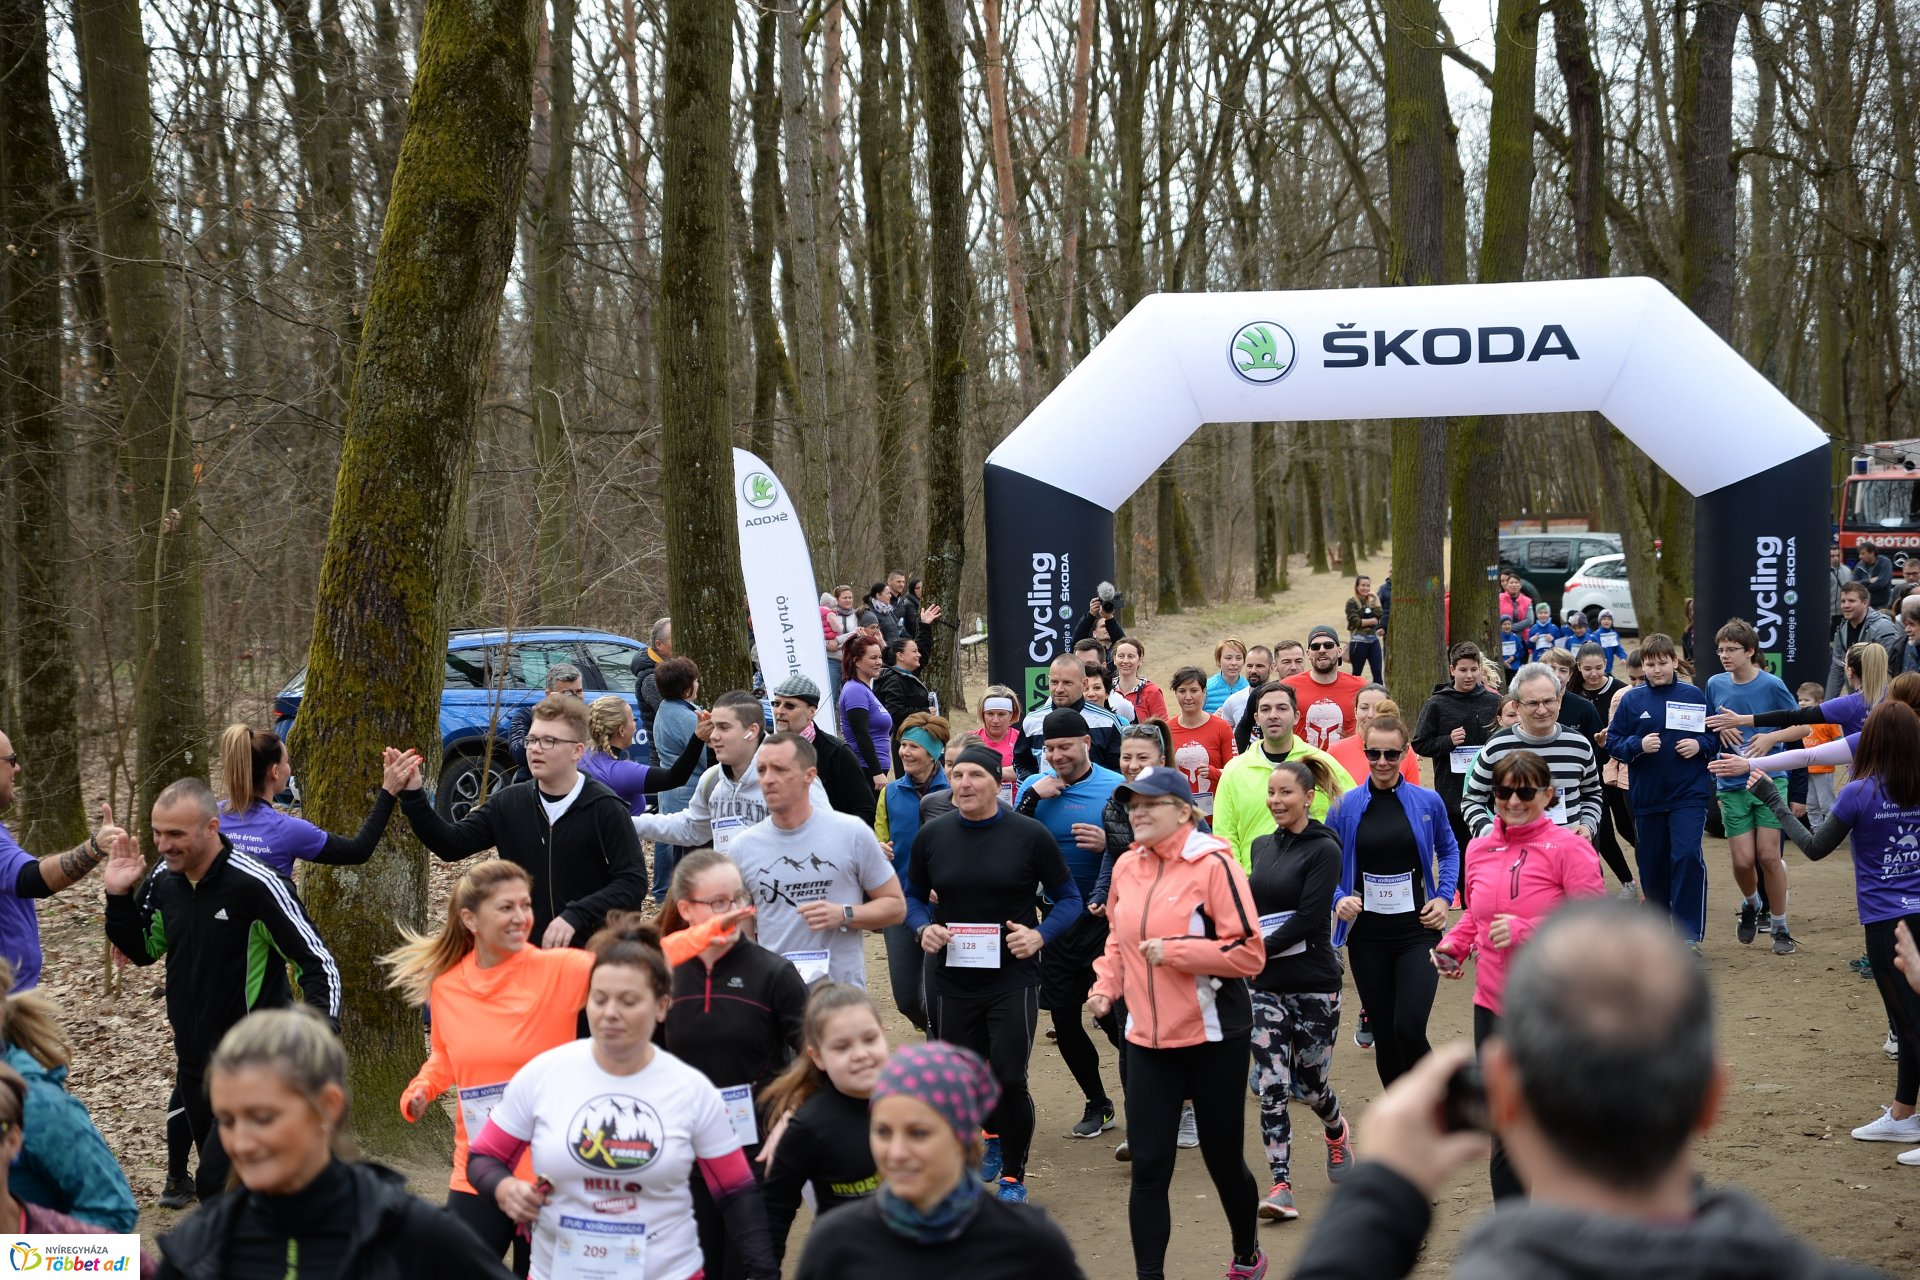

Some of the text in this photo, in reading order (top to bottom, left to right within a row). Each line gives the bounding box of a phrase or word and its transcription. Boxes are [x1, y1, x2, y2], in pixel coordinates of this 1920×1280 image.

[1322, 322, 1581, 368] ŠKODA
[1785, 536, 1796, 587] ŠKODA
[1059, 552, 1070, 602] ŠKODA
[1750, 536, 1783, 649] Cycling
[1027, 552, 1058, 663] Cycling
[1786, 617, 1797, 662] Hajtóereje
[1882, 801, 1891, 810] Én
[1874, 808, 1920, 820] Jótékony sportol
[246, 845, 273, 854] vagyok.
[1883, 850, 1920, 864] BÁTO
[789, 887, 829, 898] TRAIL
[1379, 890, 1393, 898] 175
[962, 942, 976, 950] 128
[583, 1177, 621, 1192] HELL
[831, 1175, 878, 1195] UNDE
[583, 1244, 608, 1258] 209
